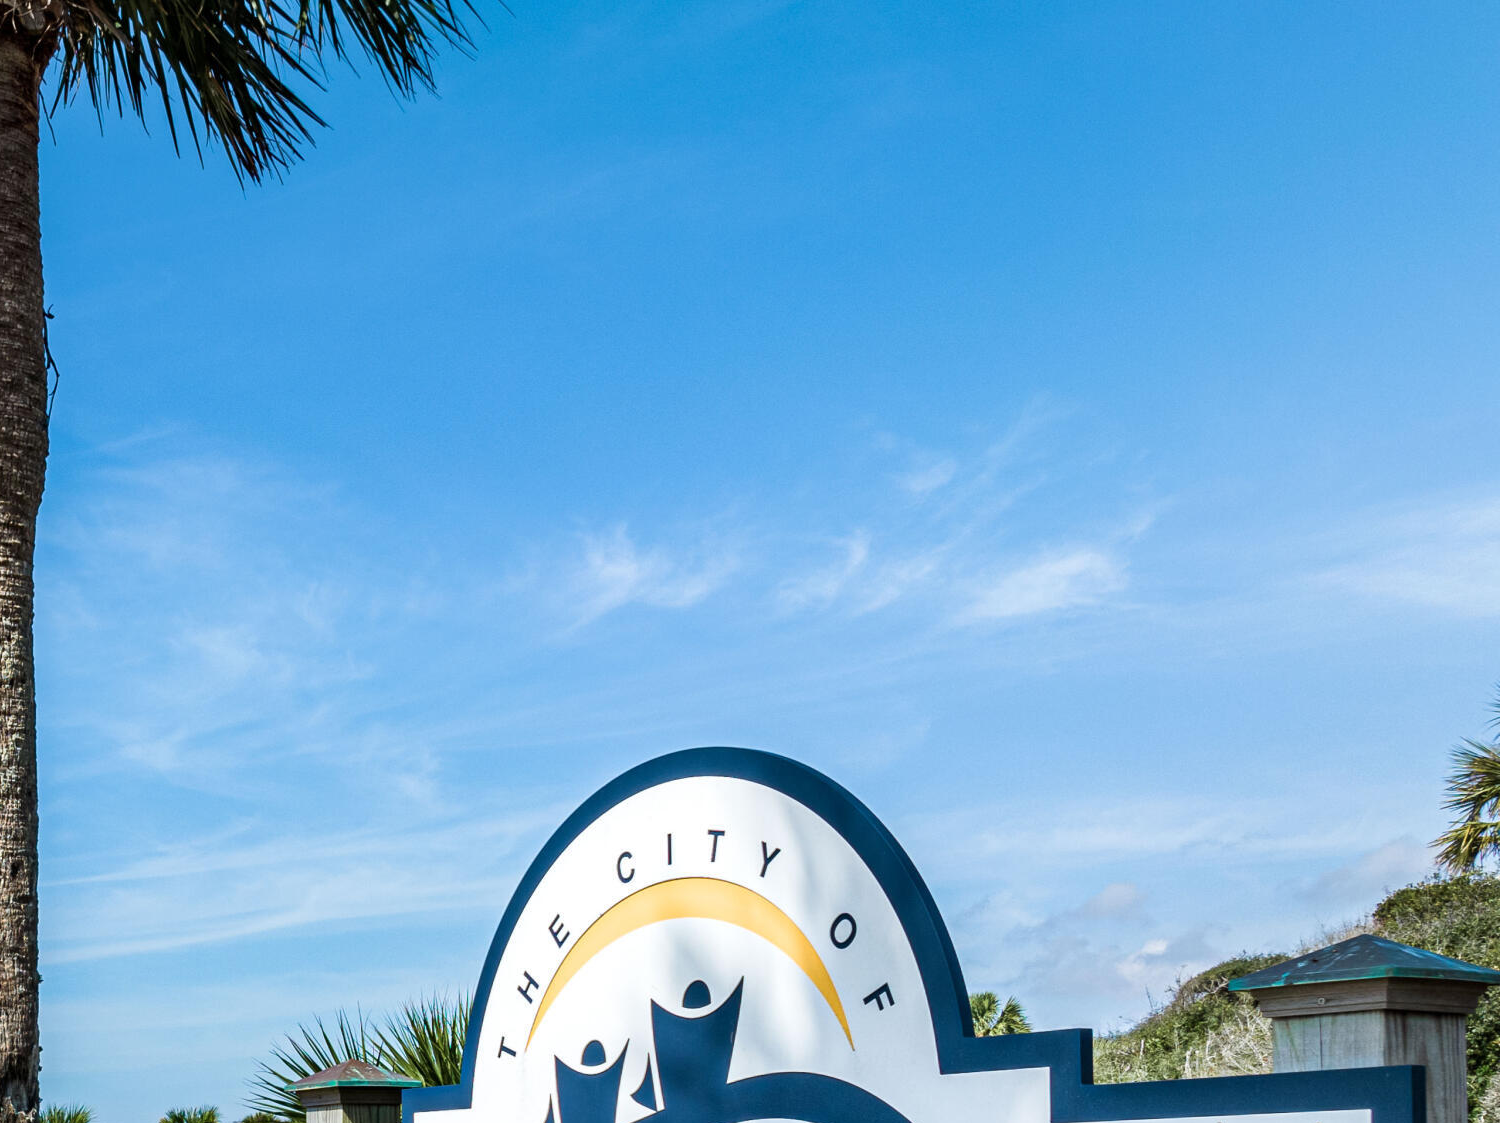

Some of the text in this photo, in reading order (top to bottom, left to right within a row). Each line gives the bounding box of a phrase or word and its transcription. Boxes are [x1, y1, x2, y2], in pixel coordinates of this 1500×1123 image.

[498, 830, 896, 1058] THE CITY OF
